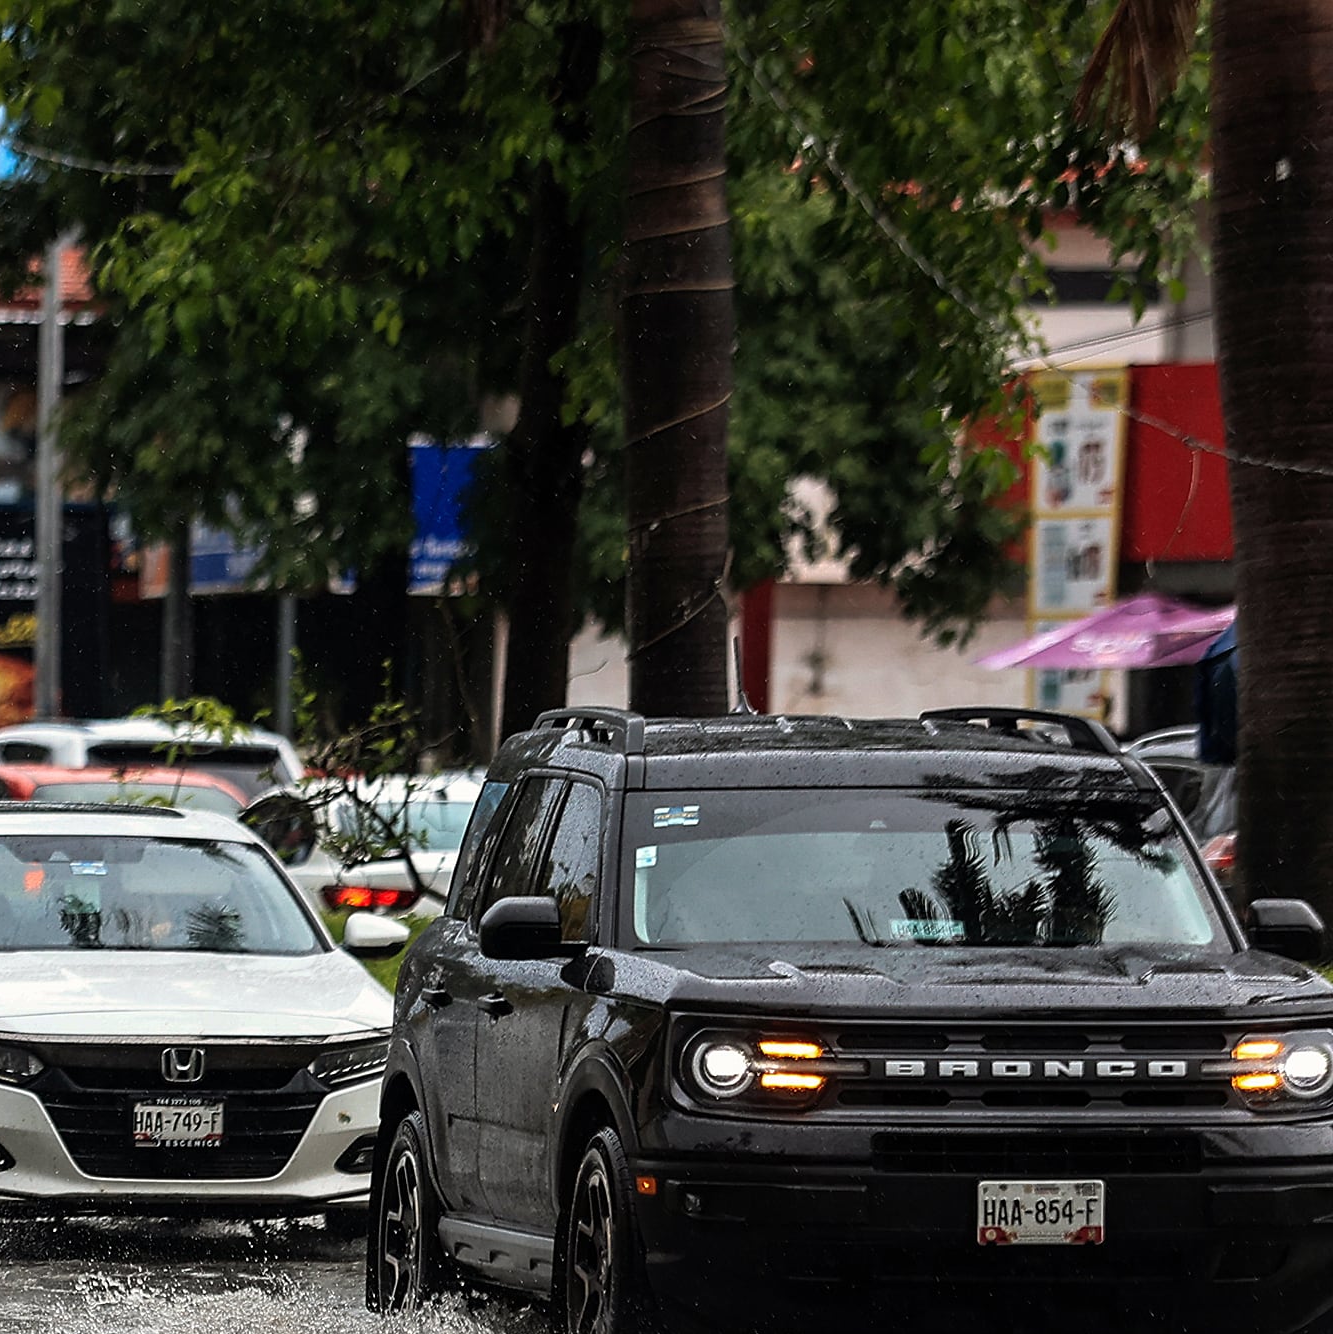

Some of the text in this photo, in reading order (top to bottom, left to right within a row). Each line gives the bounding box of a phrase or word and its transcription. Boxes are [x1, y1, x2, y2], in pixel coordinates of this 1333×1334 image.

[885, 1060, 1188, 1078] BRONCO
[134, 1111, 221, 1132] HAA-749-F
[983, 1198, 1099, 1226] HAA-854-F
